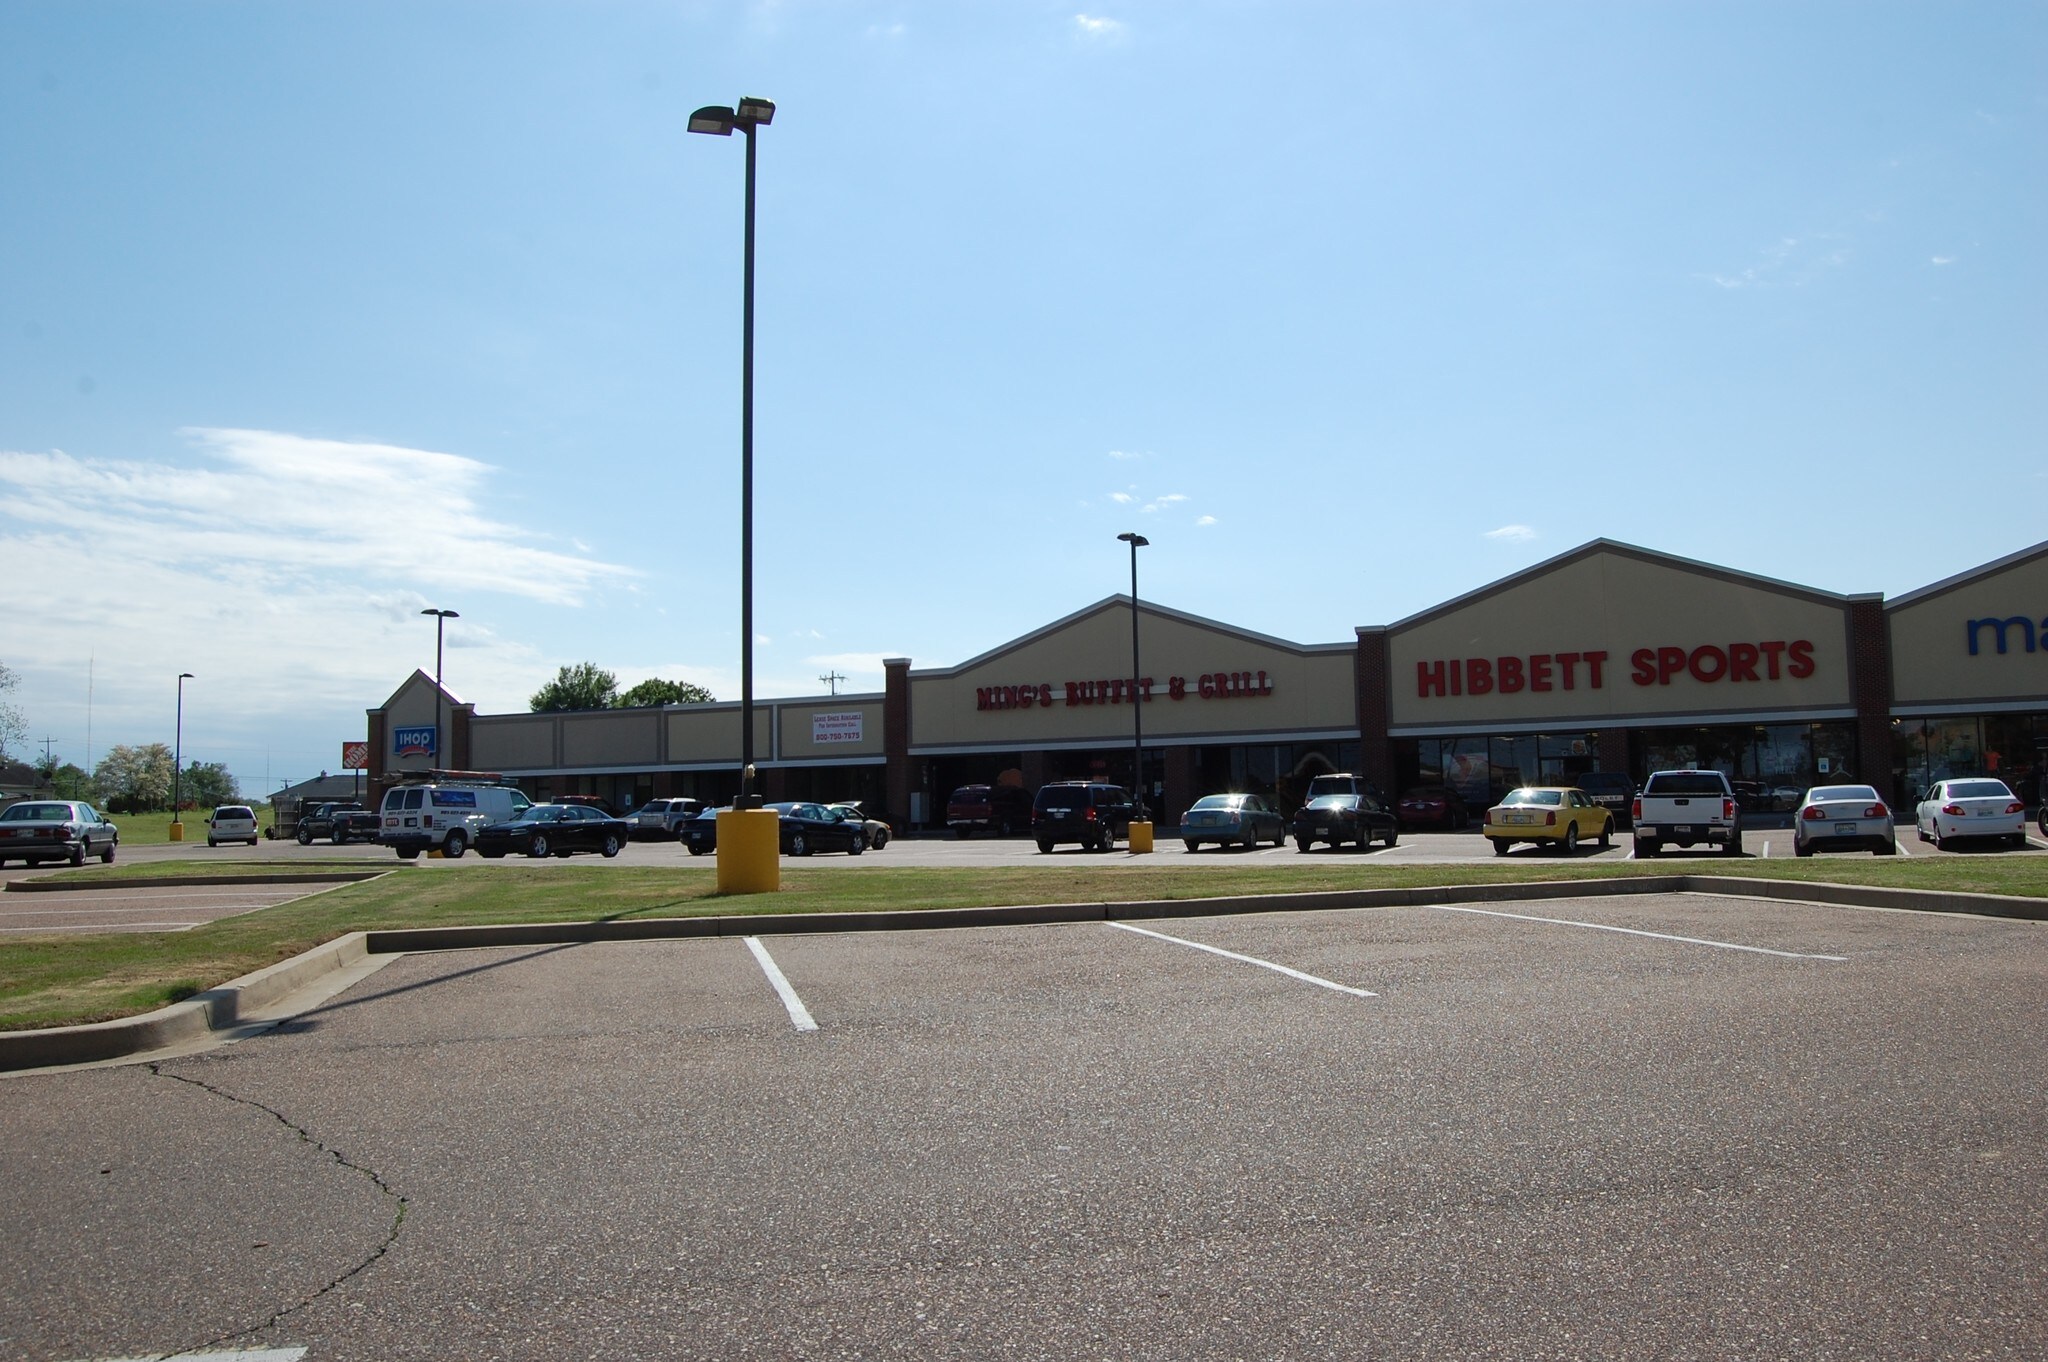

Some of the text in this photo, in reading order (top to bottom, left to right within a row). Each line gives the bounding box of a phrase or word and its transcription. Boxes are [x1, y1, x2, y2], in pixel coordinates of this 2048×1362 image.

[1967, 616, 2048, 655] m
[1417, 640, 1815, 698] HIBBETT SPORTS
[976, 670, 1272, 711] MING'S BUFFET & GRILL
[400, 732, 430, 747] IHOP
